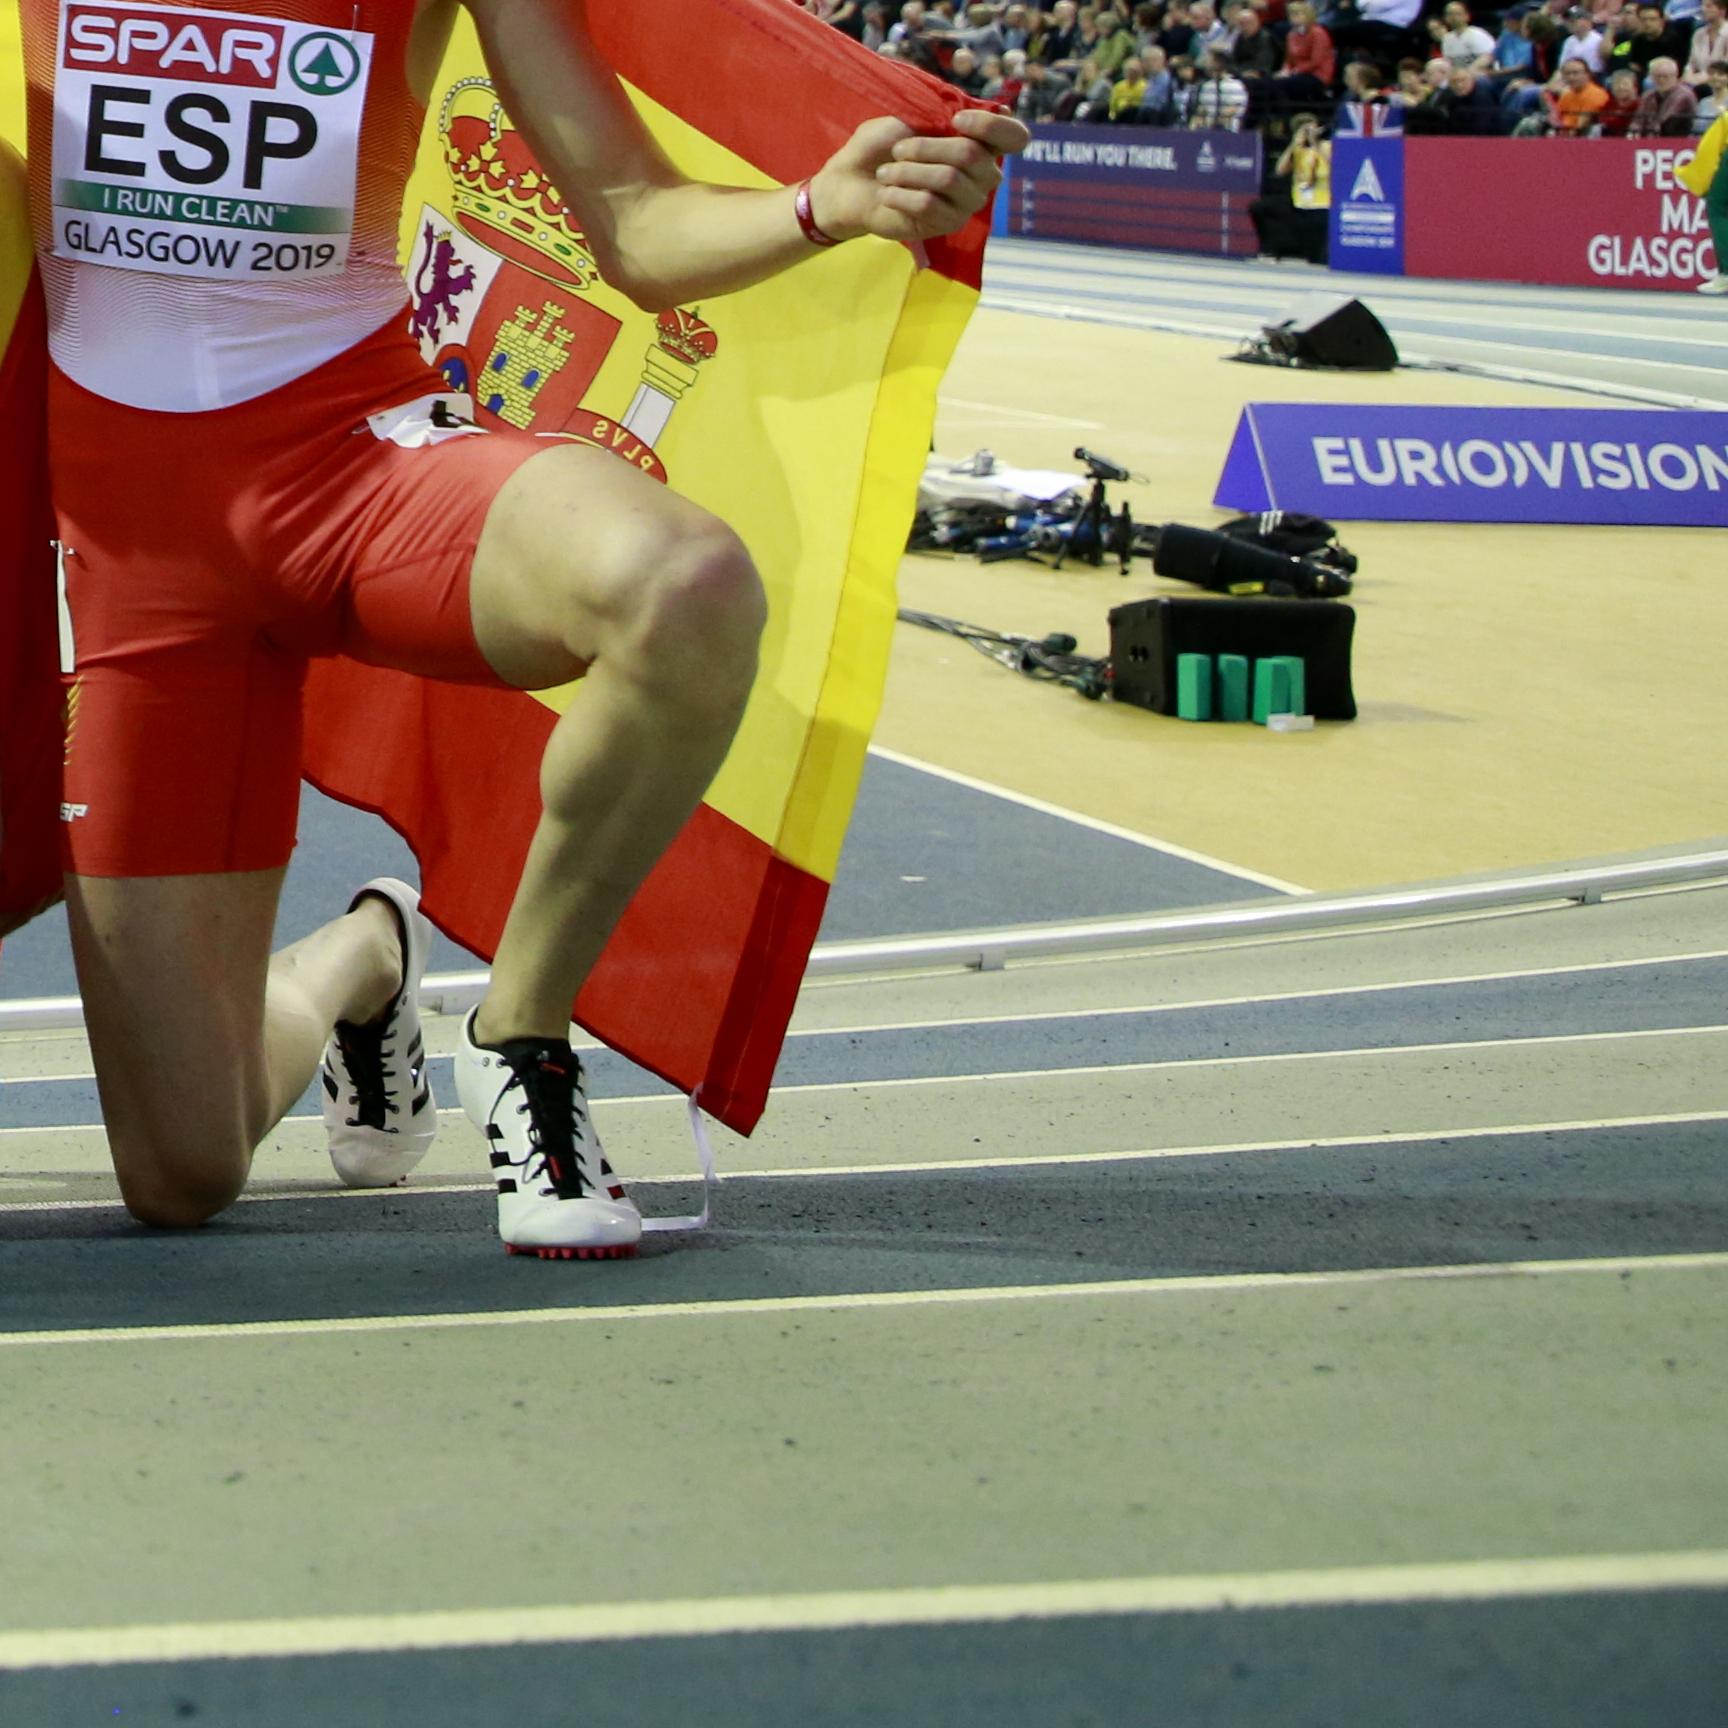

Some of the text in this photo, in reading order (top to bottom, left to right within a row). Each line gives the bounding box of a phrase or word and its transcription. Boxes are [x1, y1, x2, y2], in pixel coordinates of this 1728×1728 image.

[69, 14, 277, 79] SPAR
[84, 84, 318, 190] ESP
[1062, 141, 1095, 165] RUN
[1096, 143, 1126, 167] YOU
[102, 188, 110, 208] I
[116, 189, 175, 216] RUN
[64, 220, 336, 272] GLASGOW 2019
